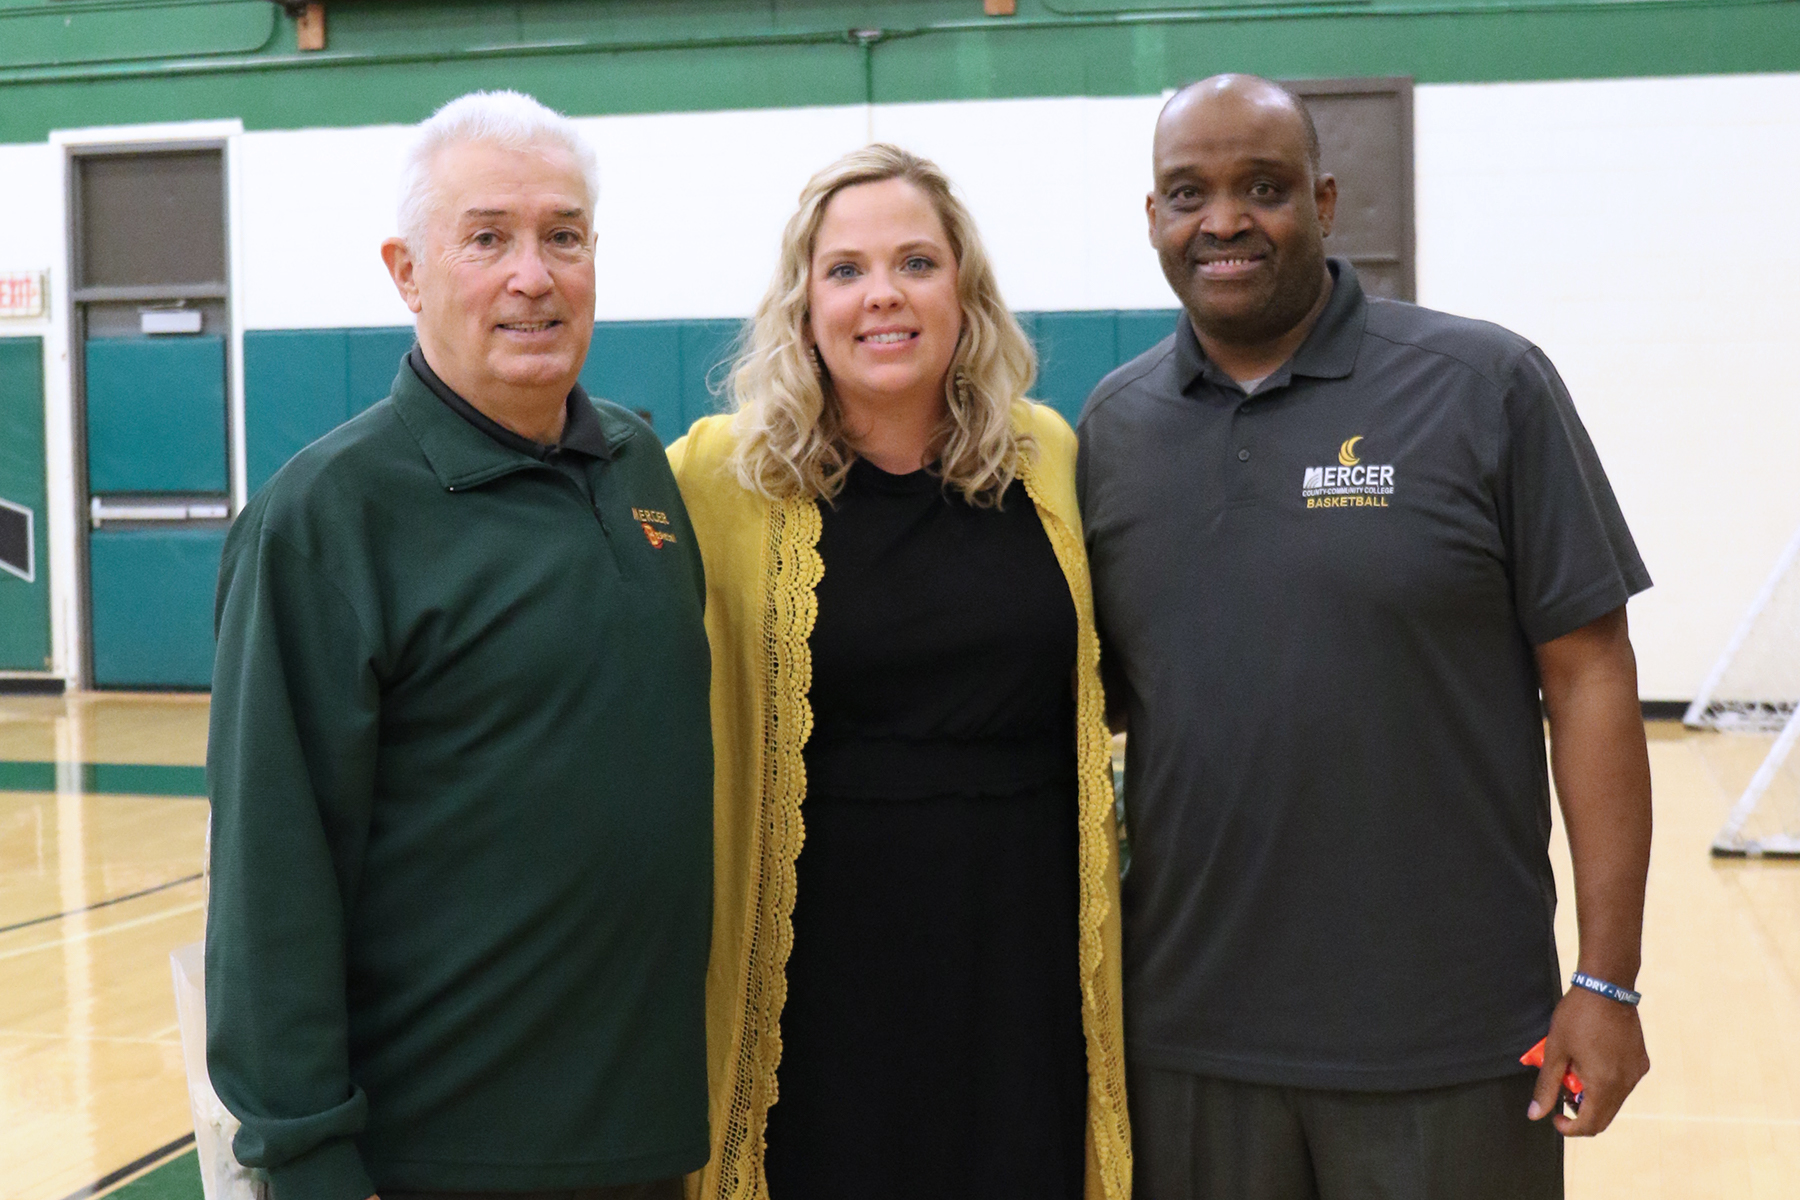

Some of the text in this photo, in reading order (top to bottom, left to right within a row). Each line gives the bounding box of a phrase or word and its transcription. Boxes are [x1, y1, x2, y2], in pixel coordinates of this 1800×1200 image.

[1303, 465, 1394, 488] MERCER
[1364, 486, 1394, 494] COLLEGE
[1307, 496, 1388, 508] BASKETBALL
[1585, 978, 1607, 992] DRV
